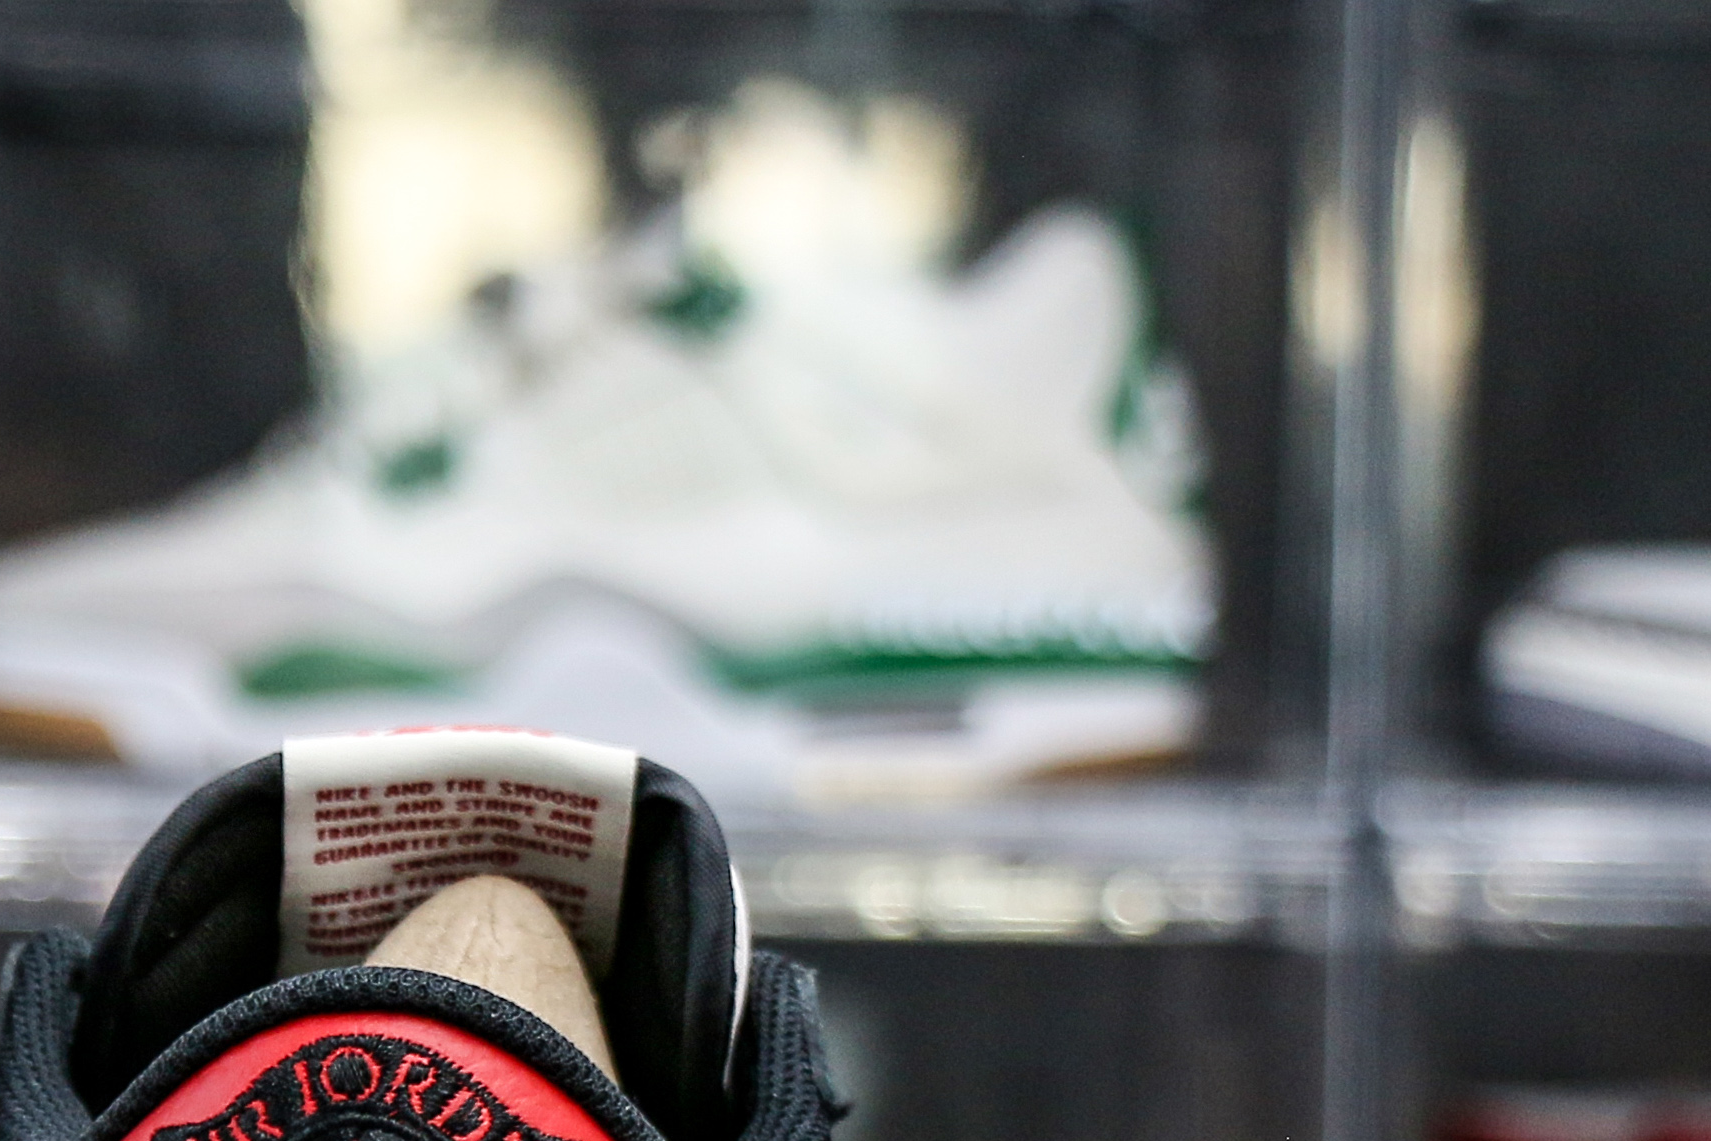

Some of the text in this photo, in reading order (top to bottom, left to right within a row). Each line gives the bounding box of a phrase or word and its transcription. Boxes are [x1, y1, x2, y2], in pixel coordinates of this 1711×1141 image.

[385, 782, 434, 798] AND
[447, 780, 486, 794] THE
[500, 780, 598, 811] SWOOSH
[396, 800, 443, 815] AND
[474, 817, 521, 831] AND
[315, 836, 448, 865] GUARANTEE
[458, 834, 484, 845] OF
